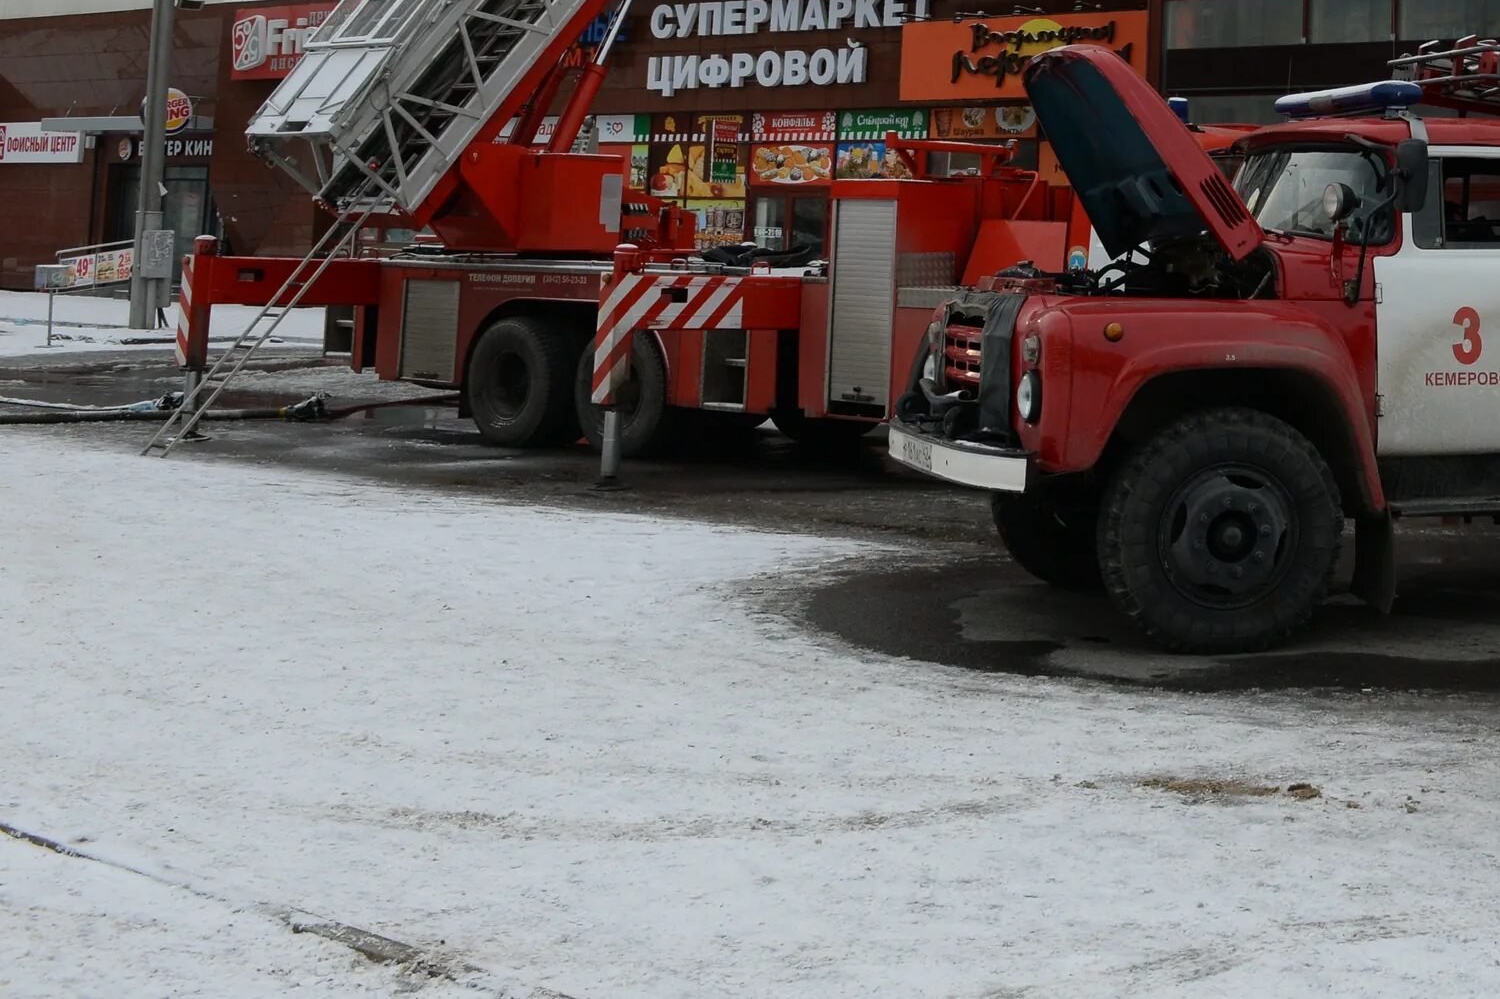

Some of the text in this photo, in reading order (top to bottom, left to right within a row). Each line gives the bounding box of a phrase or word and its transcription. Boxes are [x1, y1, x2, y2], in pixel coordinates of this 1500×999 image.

[647, 38, 868, 97] ЦИФРОВОЙ
[7, 133, 77, 154] ОФИСНЫЙ ЦЕНТР
[468, 273, 501, 283] ТЕЛЕФОН
[502, 274, 536, 284] ДОВЕРИЯ
[1451, 306, 1482, 365] 3
